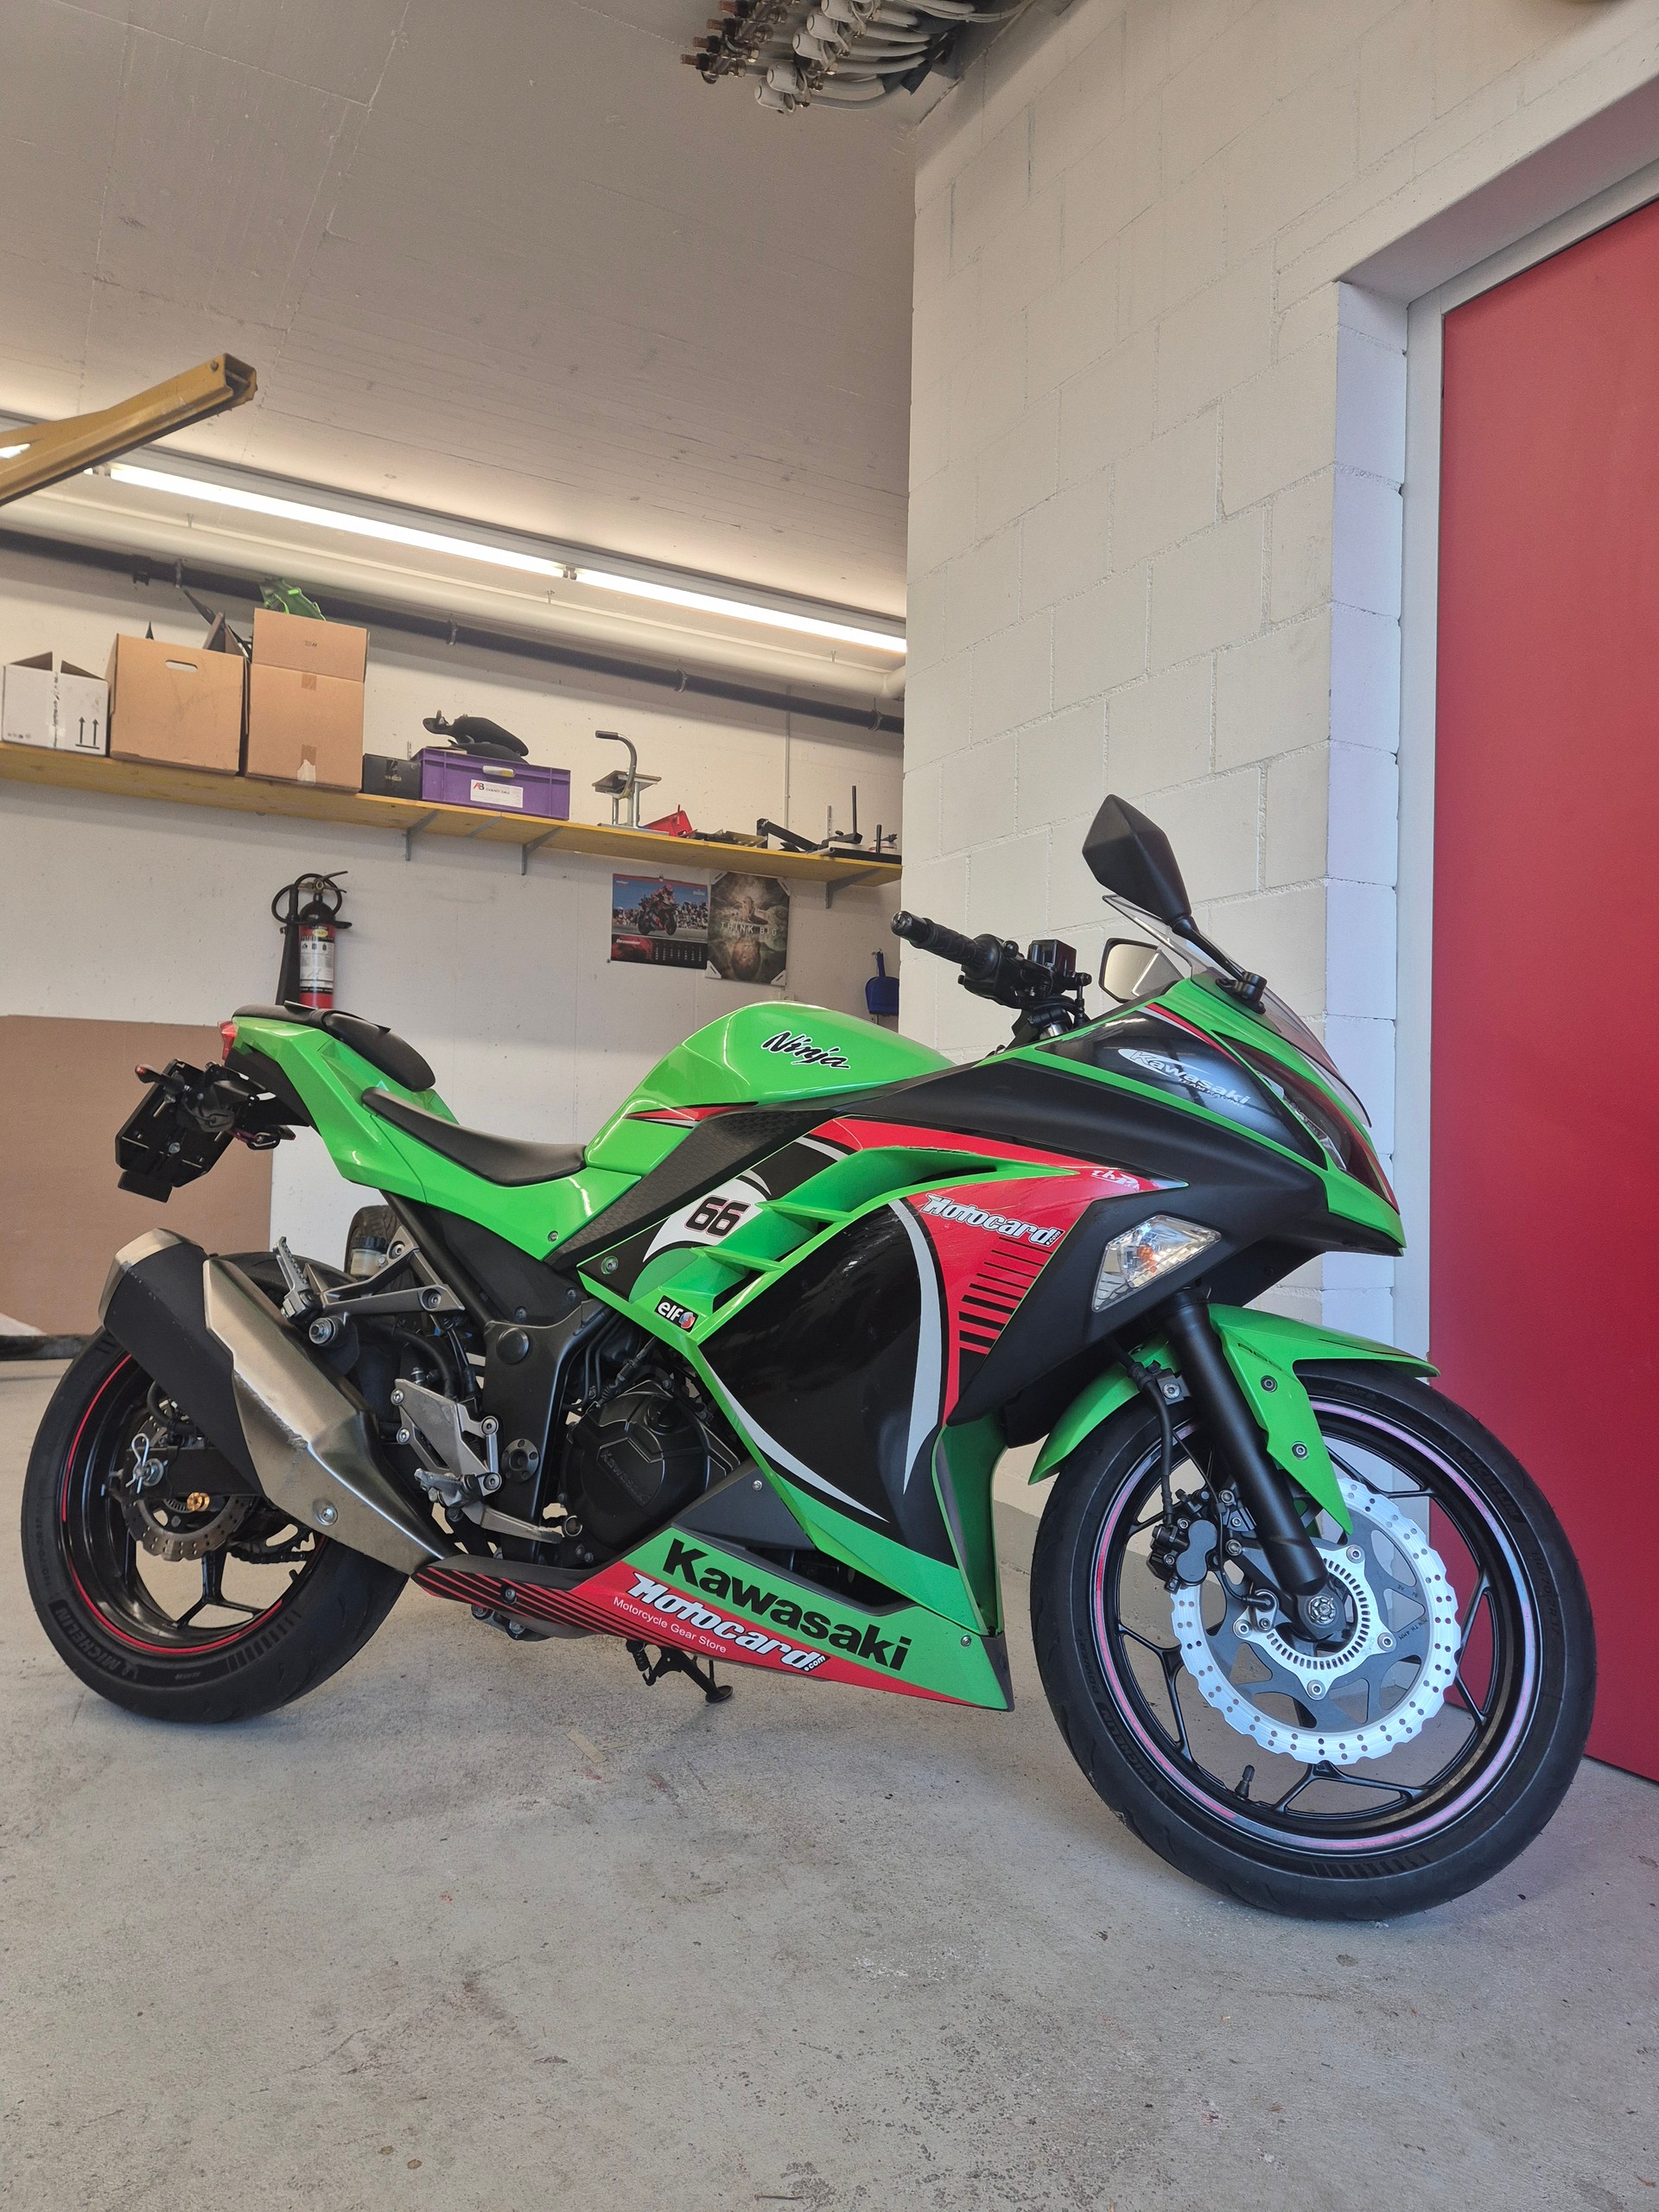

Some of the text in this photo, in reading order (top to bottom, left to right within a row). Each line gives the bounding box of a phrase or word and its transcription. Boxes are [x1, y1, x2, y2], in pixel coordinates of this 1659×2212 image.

[721, 921, 777, 937] THINK BIG
[761, 1031, 851, 1070] Ninja
[1129, 1051, 1251, 1104] Kawasaki
[1179, 1077, 1205, 1092] TEAM
[684, 1195, 751, 1238] 66
[658, 1301, 684, 1321] elf
[613, 1597, 727, 1654] Motorcycle Gear Store
[662, 1538, 912, 1671] Kawasaki
[56, 1606, 122, 1673] MICHELIN
